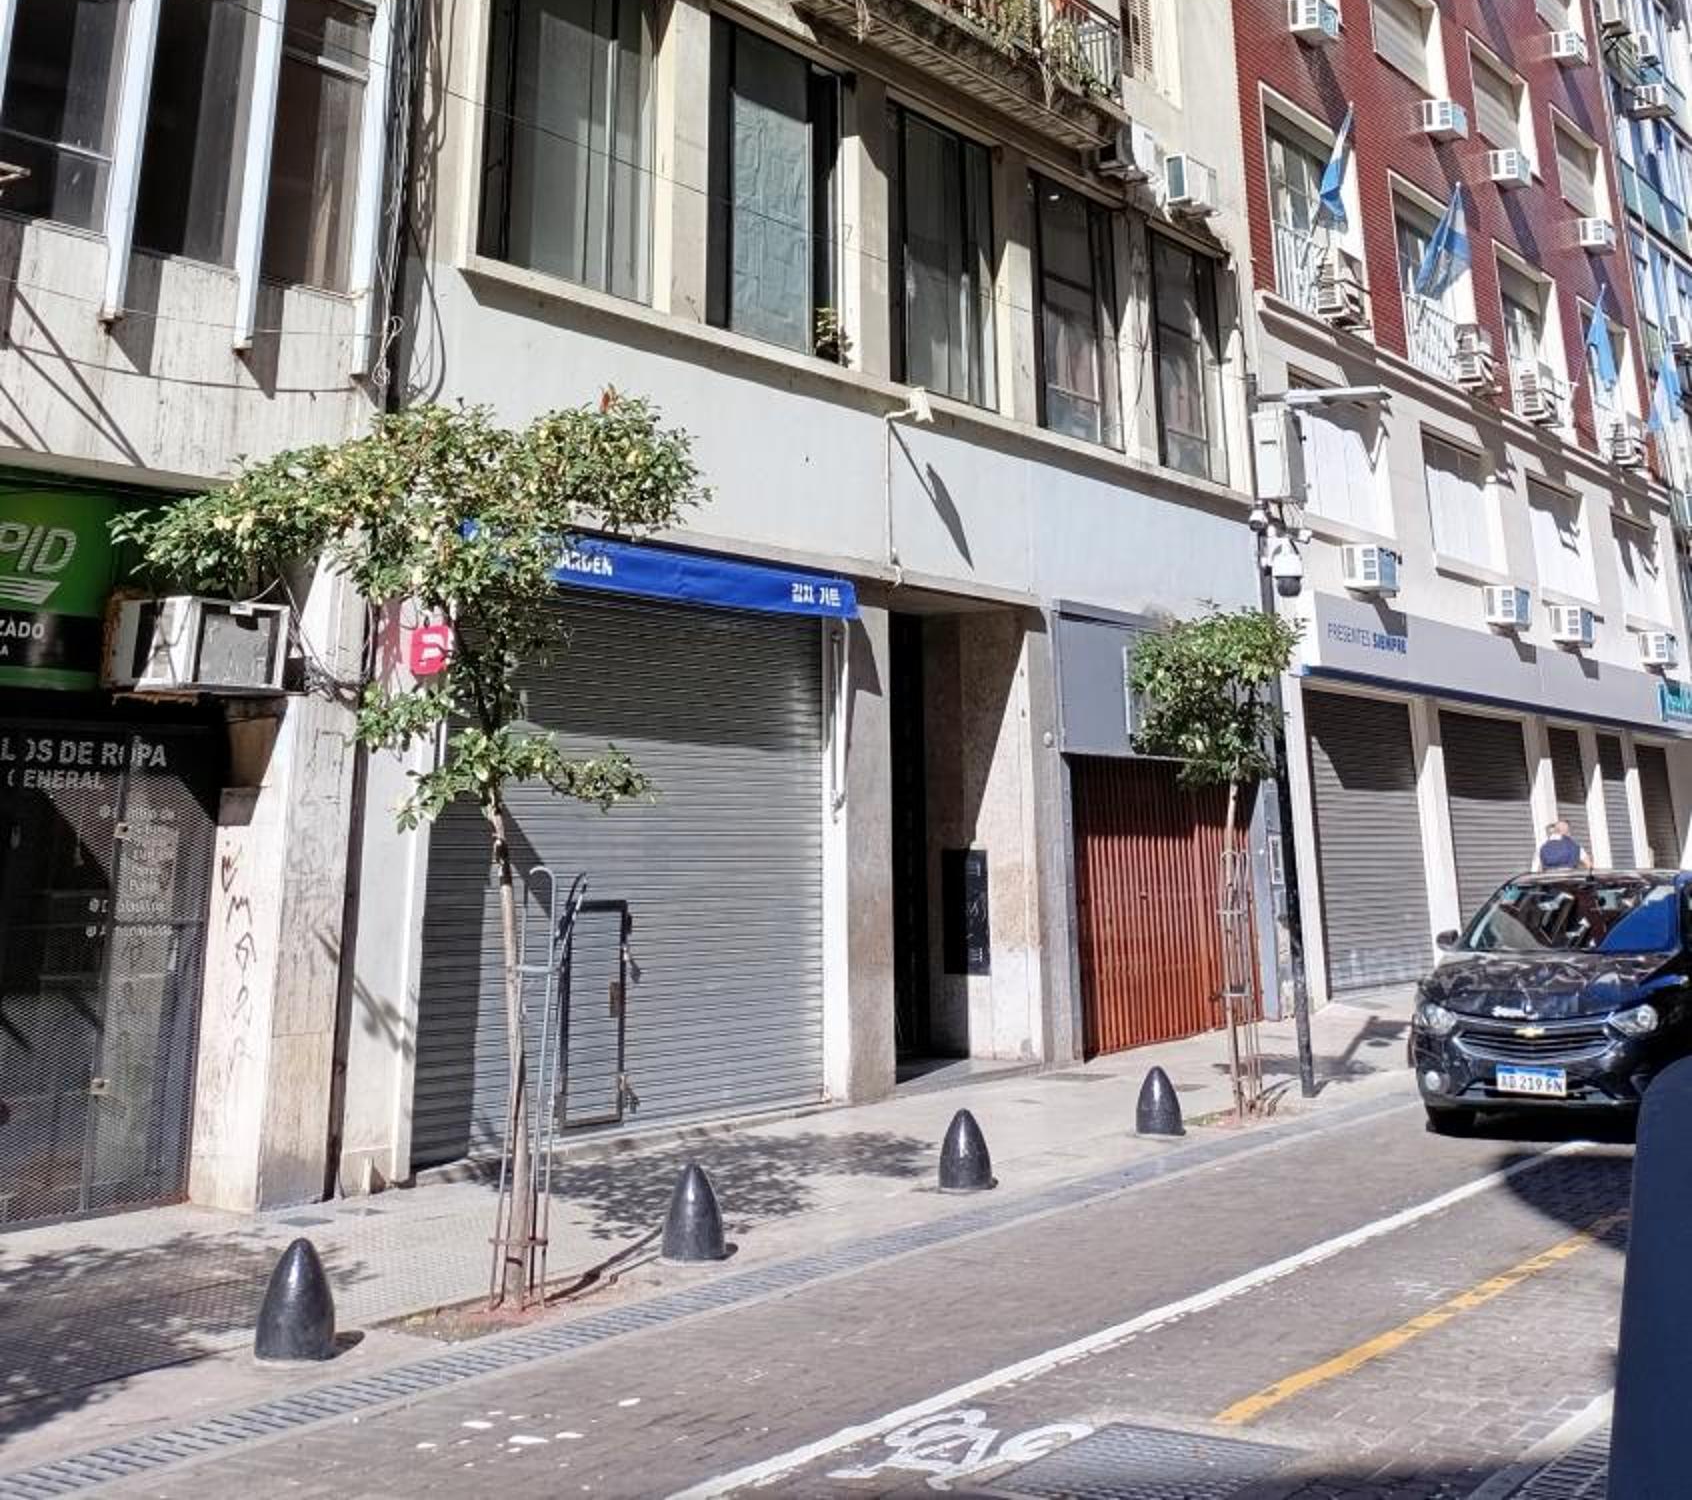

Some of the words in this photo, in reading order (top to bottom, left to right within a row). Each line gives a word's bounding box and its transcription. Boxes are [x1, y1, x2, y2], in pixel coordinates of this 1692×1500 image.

[1327, 622, 1371, 647] PRESENTES
[1373, 632, 1407, 655] SIEMPRE
[59, 739, 95, 765] DE
[1520, 1076, 1543, 1091] 219
